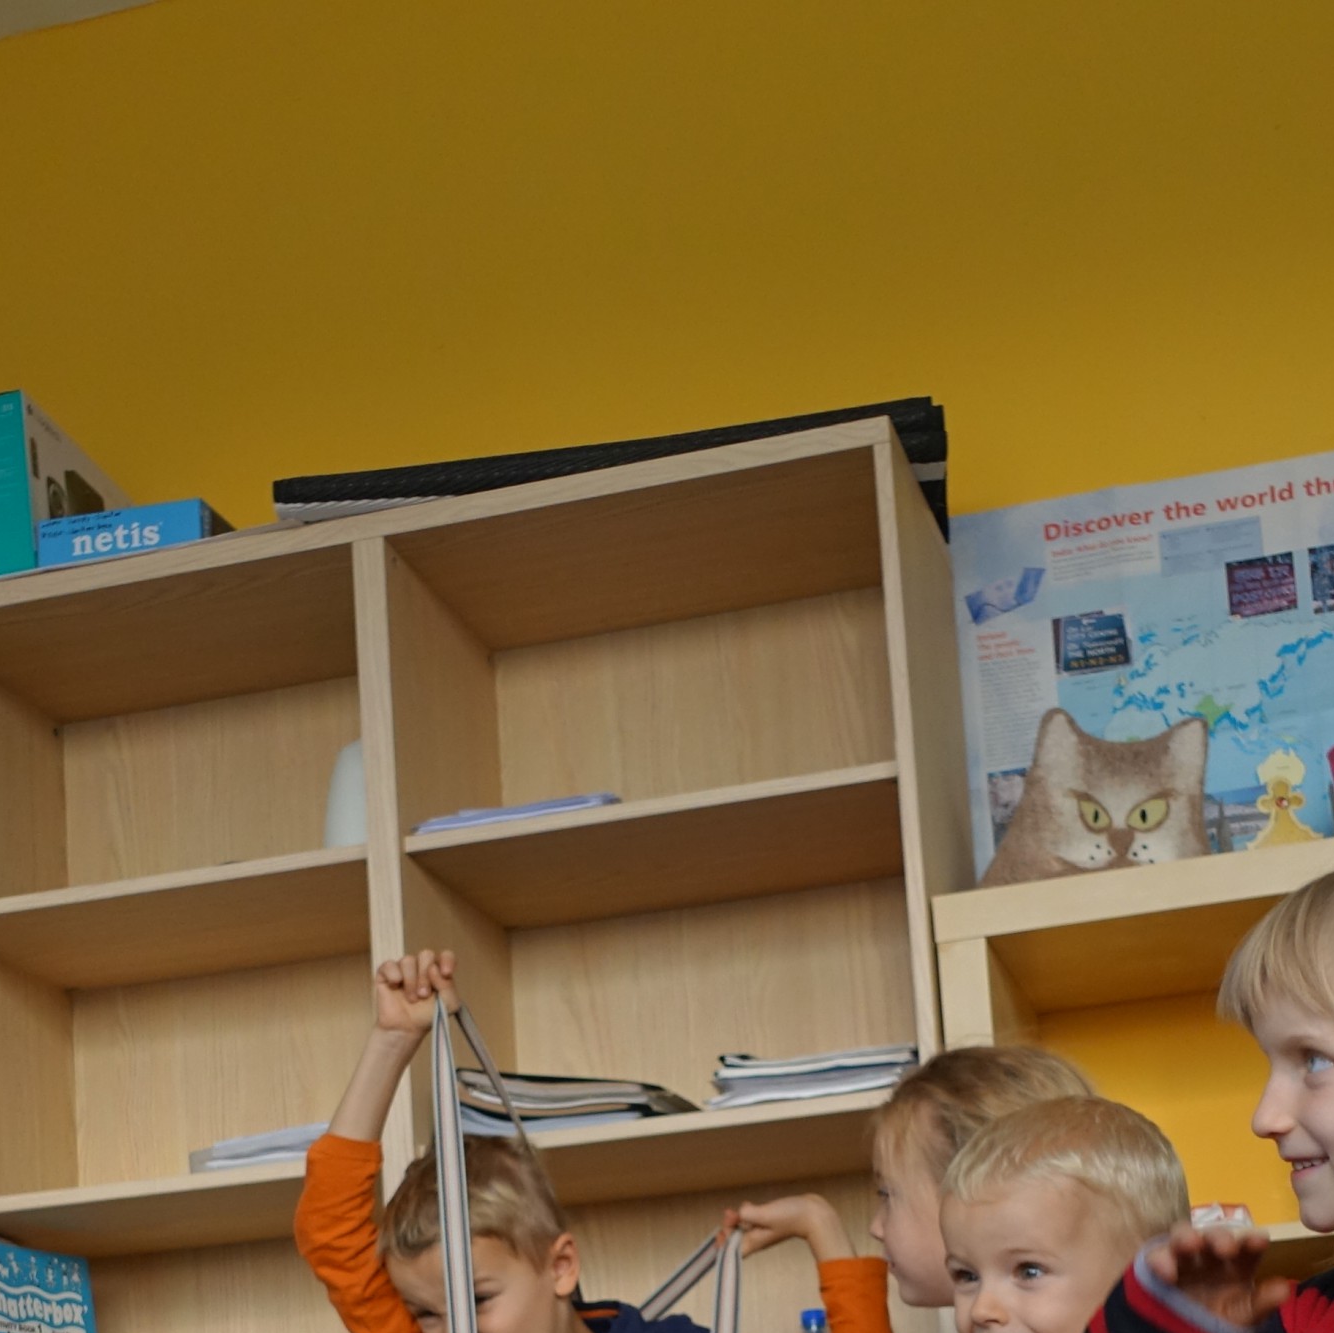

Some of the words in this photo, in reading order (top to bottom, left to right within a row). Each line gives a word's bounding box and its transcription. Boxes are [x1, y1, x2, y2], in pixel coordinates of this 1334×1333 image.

[1043, 508, 1154, 541] Discover
[1163, 501, 1206, 521] the
[1216, 482, 1294, 512] world
[72, 521, 161, 556] netis
